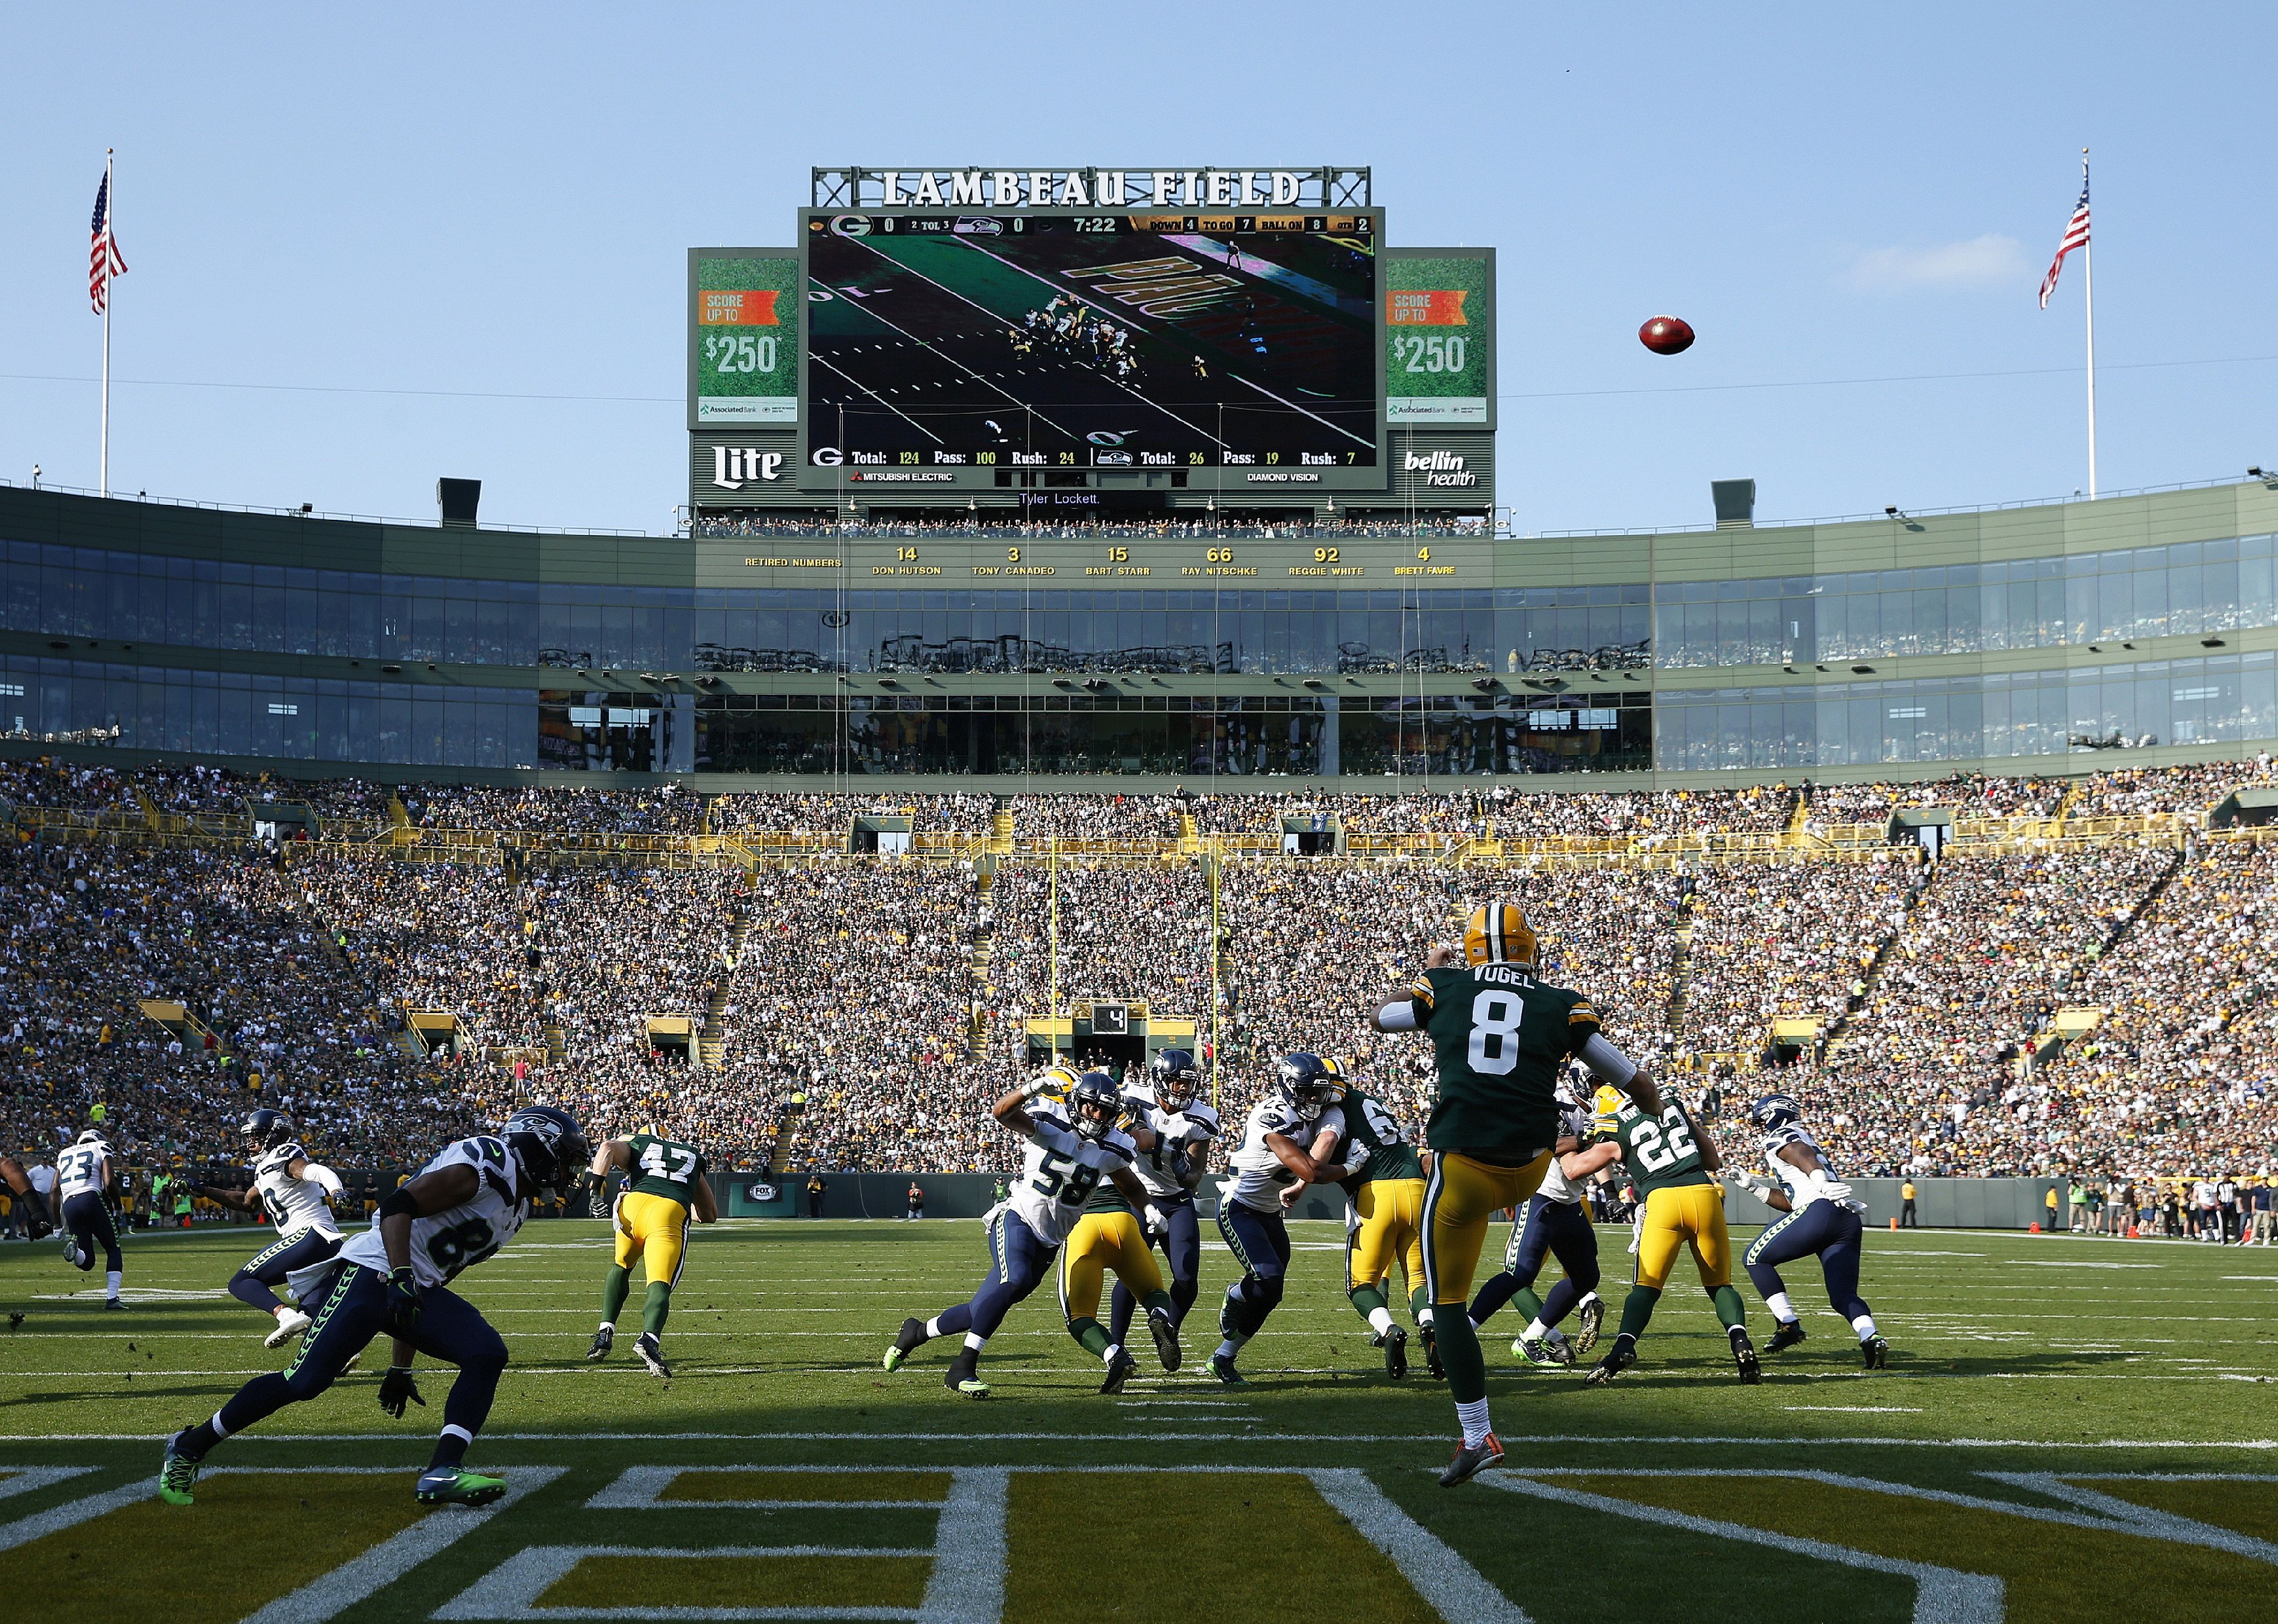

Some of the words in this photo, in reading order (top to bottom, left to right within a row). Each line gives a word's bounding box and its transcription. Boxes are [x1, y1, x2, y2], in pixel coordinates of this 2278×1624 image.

[884, 172, 1125, 205] LAMBEAU
[1153, 172, 1302, 205] FIELD
[885, 218, 894, 232] 0
[922, 222, 940, 230] TOL
[1014, 218, 1023, 232] 0
[1074, 218, 1115, 232] 7:22
[1150, 221, 1181, 230] DOWN
[1187, 219, 1194, 229] 4
[1203, 221, 1217, 230] TO
[1220, 221, 1233, 230] GO
[1243, 219, 1250, 229] 7
[1261, 221, 1287, 230] BALL
[1289, 221, 1302, 230] ON
[1313, 219, 1320, 229] 8
[1359, 218, 1367, 231] 2
[707, 294, 743, 308] SCORE
[1395, 295, 1431, 308] SCORE
[707, 309, 722, 322] UP
[725, 309, 737, 322] TO
[1395, 309, 1409, 322] UP
[1413, 309, 1426, 322] TO
[851, 451, 887, 464] Total:
[899, 451, 919, 464] 124
[934, 451, 966, 464] Pass:
[976, 452, 996, 464] 100
[1012, 451, 1048, 464] Rush:
[1059, 452, 1075, 464] 24
[1140, 452, 1176, 464] Total:
[1189, 452, 1204, 464] 26
[1223, 451, 1255, 464] Pass:
[1266, 452, 1279, 464] 19
[1301, 452, 1336, 465] Rush:
[1347, 452, 1355, 464] 7
[1404, 451, 1464, 471] bellin
[711, 446, 782, 489] Lite
[1427, 468, 1476, 486] health
[1020, 493, 1049, 505] Tyler
[1055, 493, 1100, 504] Lockett.
[896, 546, 918, 561] 14
[1008, 547, 1020, 562] 3
[1107, 547, 1128, 562] 15
[1206, 547, 1232, 562] 66
[1314, 547, 1339, 562] 92
[1417, 546, 1430, 561] 4
[745, 558, 788, 566] RETIRED
[793, 558, 842, 567] NUMBERS
[873, 566, 894, 575] DON
[899, 566, 942, 575] HUTSON
[972, 566, 1000, 575] TONY
[1005, 566, 1056, 575] CANADEO
[1086, 566, 1112, 576] BART
[1118, 567, 1150, 576] STARR
[1181, 566, 1200, 576] RAY
[1206, 566, 1258, 576] NITSCHKE
[1289, 567, 1327, 576] REGGIE
[1331, 567, 1364, 576] WHITE
[1394, 566, 1424, 575] BRETT
[1427, 566, 1456, 575] FAVRE
[1109, 1010, 1124, 1029] 4
[1467, 989, 1524, 1076] 8
[1629, 1104, 1698, 1173] 22
[59, 1150, 94, 1185] 23
[639, 1141, 697, 1184] 47
[1032, 1146, 1100, 1206] 58
